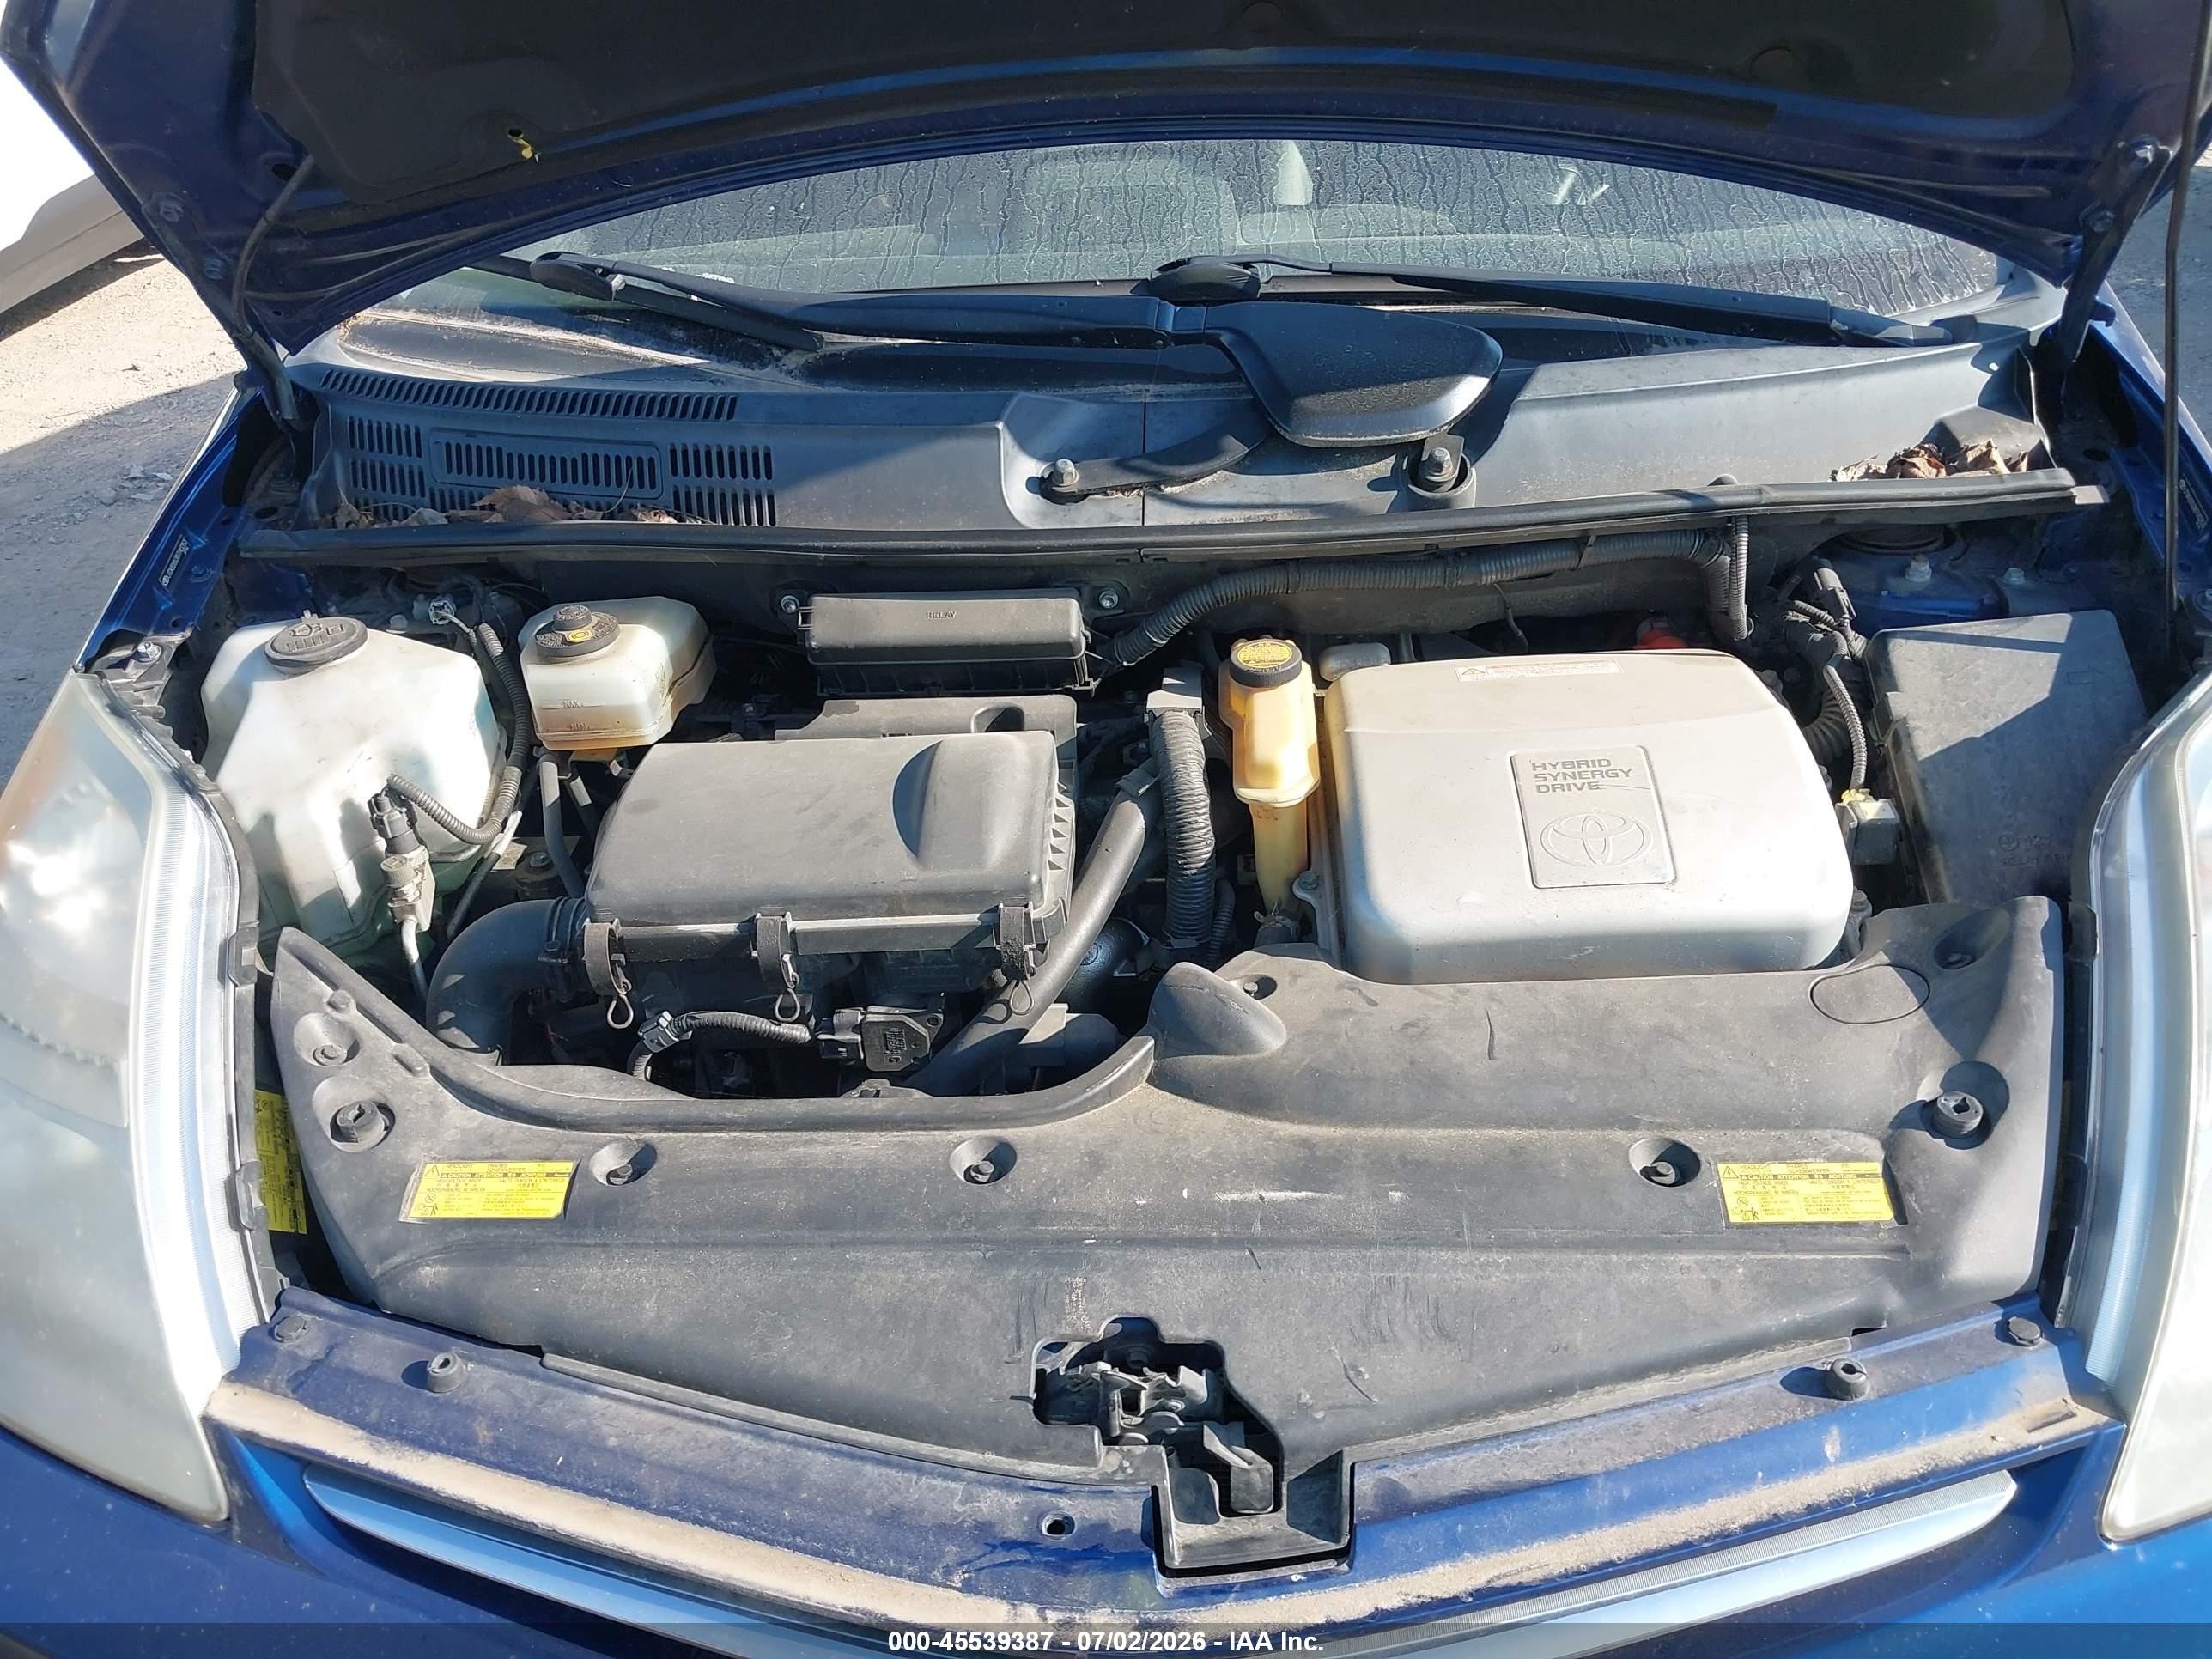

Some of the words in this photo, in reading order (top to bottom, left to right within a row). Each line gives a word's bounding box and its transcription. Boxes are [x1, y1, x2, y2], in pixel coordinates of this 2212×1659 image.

[1531, 758, 1612, 771] HYBRID
[1534, 769, 1632, 782] SYNERGY
[1536, 781, 1601, 793] DRIVE
